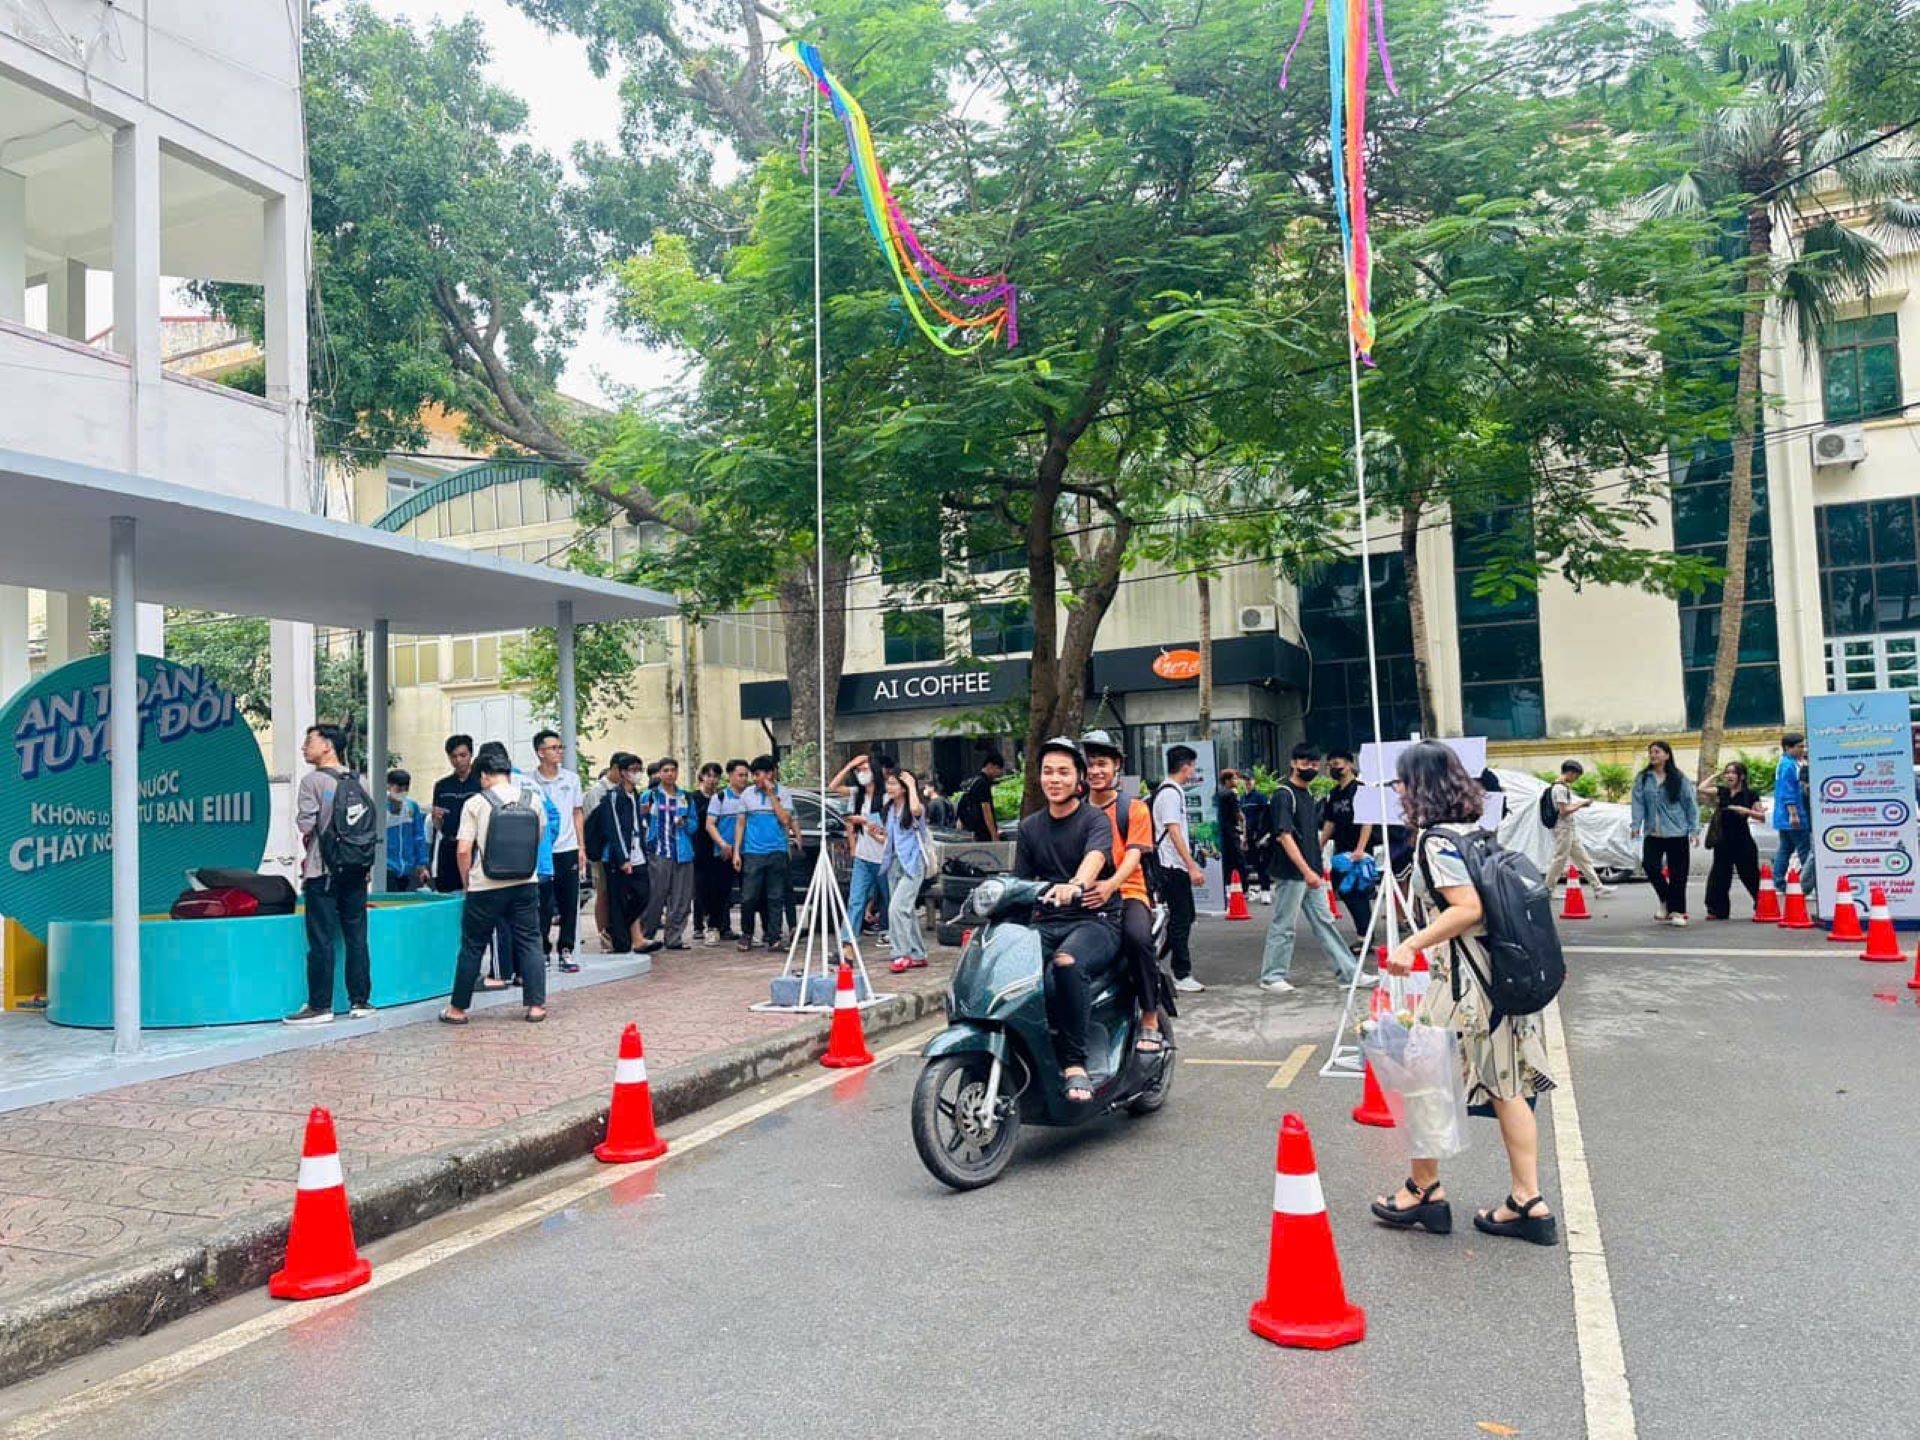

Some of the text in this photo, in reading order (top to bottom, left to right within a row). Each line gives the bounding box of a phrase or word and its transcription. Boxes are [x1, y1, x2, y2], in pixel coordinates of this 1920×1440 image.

[873, 672, 991, 701] AI COFFEE
[15, 689, 82, 737] AN
[31, 801, 96, 826] KHÔNG
[156, 797, 194, 828] BẠN
[9, 828, 88, 872] CHÁY
